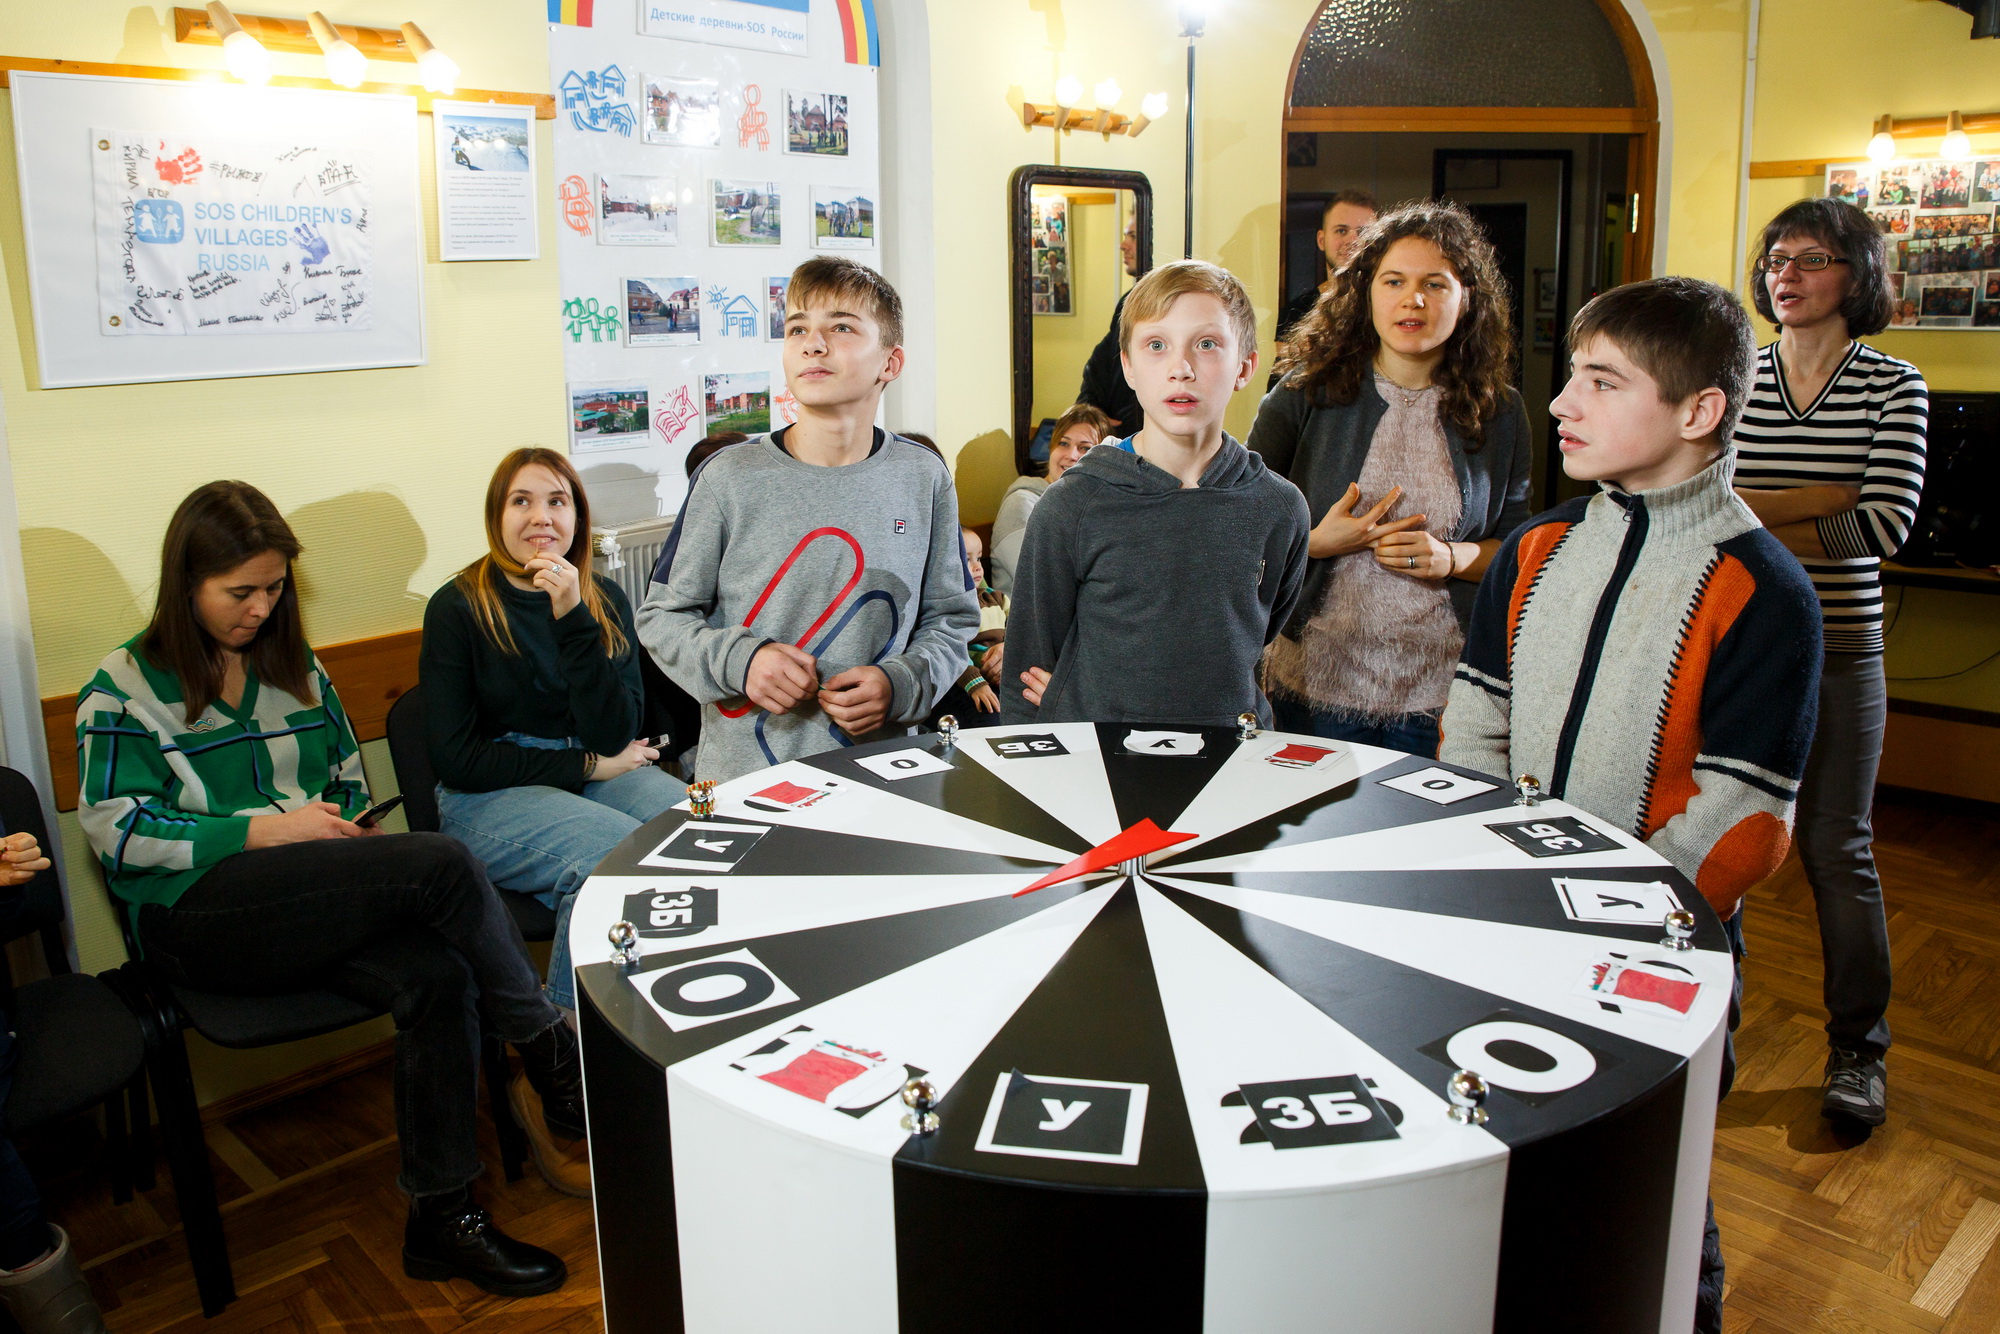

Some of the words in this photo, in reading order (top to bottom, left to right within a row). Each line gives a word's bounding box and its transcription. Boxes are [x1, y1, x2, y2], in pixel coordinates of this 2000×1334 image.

[650, 7, 695, 24] Детские
[700, 16, 766, 34] деревни-SOS
[771, 26, 804, 42] России
[194, 202, 236, 221] SOS
[241, 203, 353, 224] CHILDREN'S
[194, 228, 288, 246] VILLAGES
[199, 253, 271, 272] RUSSIA
